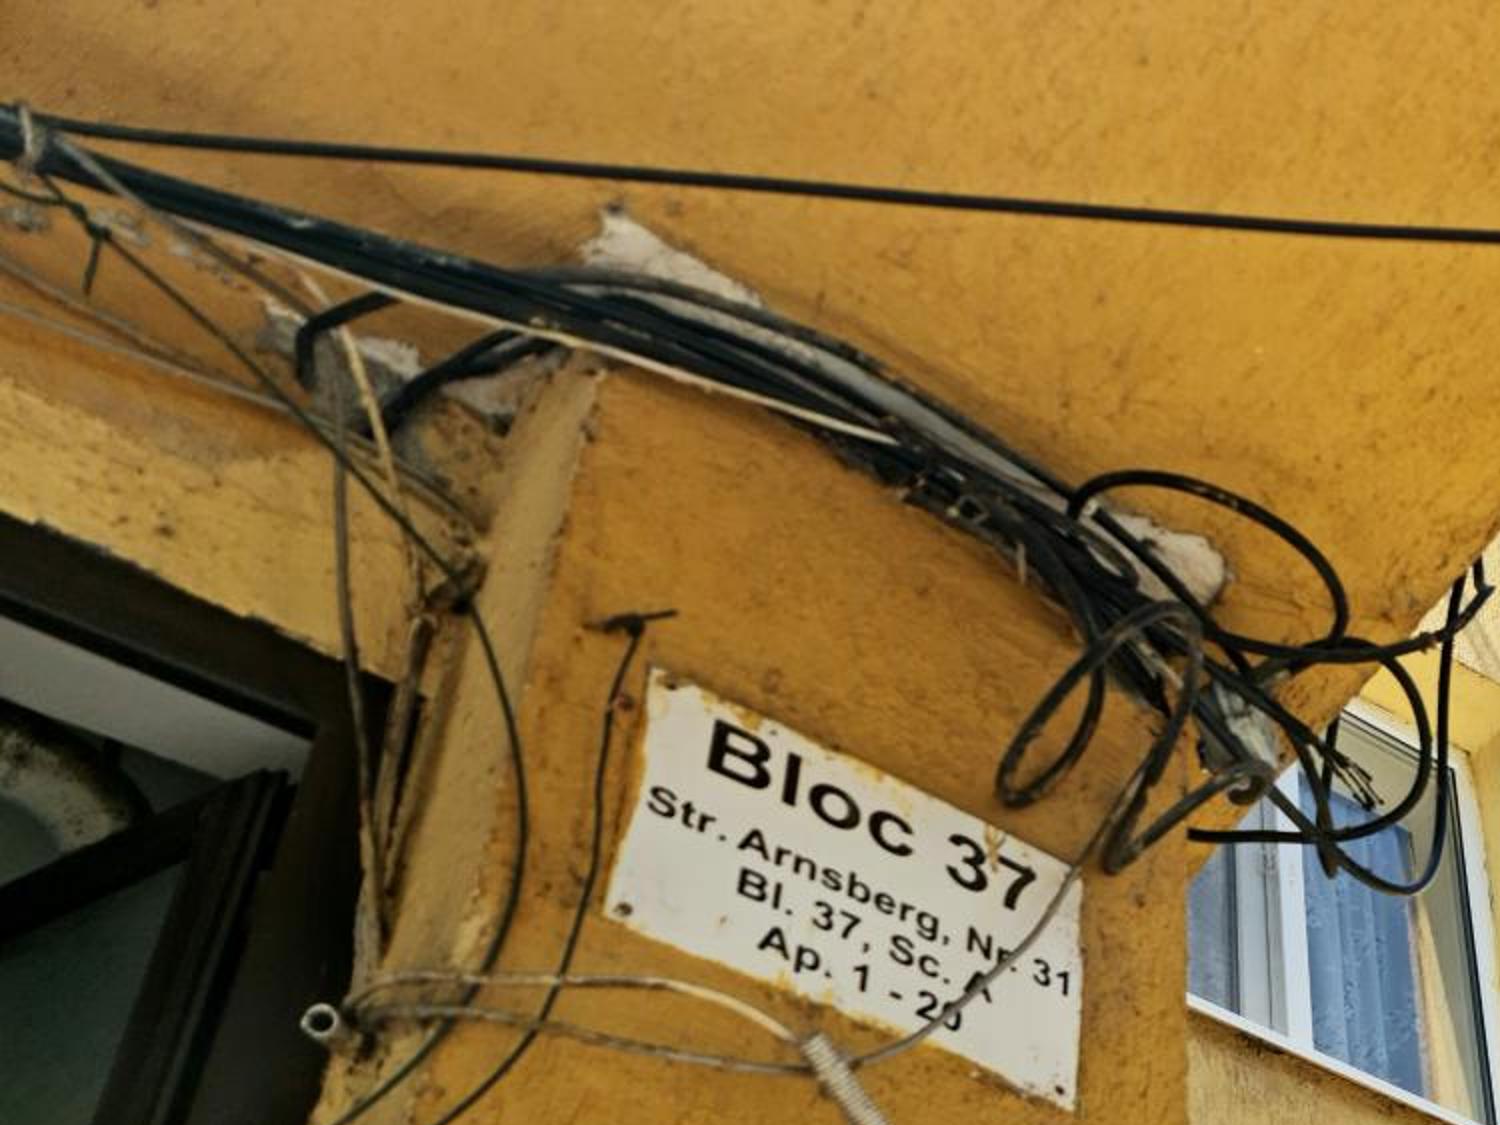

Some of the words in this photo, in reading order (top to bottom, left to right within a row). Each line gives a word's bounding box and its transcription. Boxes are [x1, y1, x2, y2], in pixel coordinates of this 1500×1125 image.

[647, 785, 727, 843] Str.
[738, 828, 949, 945] Arnsberg,
[1033, 958, 1069, 996] 31
[706, 719, 915, 857] Bloc
[946, 834, 1037, 911] 37
[737, 868, 793, 915] Bl.
[812, 901, 870, 952] 37,
[889, 934, 950, 985] Sc.
[758, 927, 832, 979] Ap.
[854, 965, 868, 993] 1
